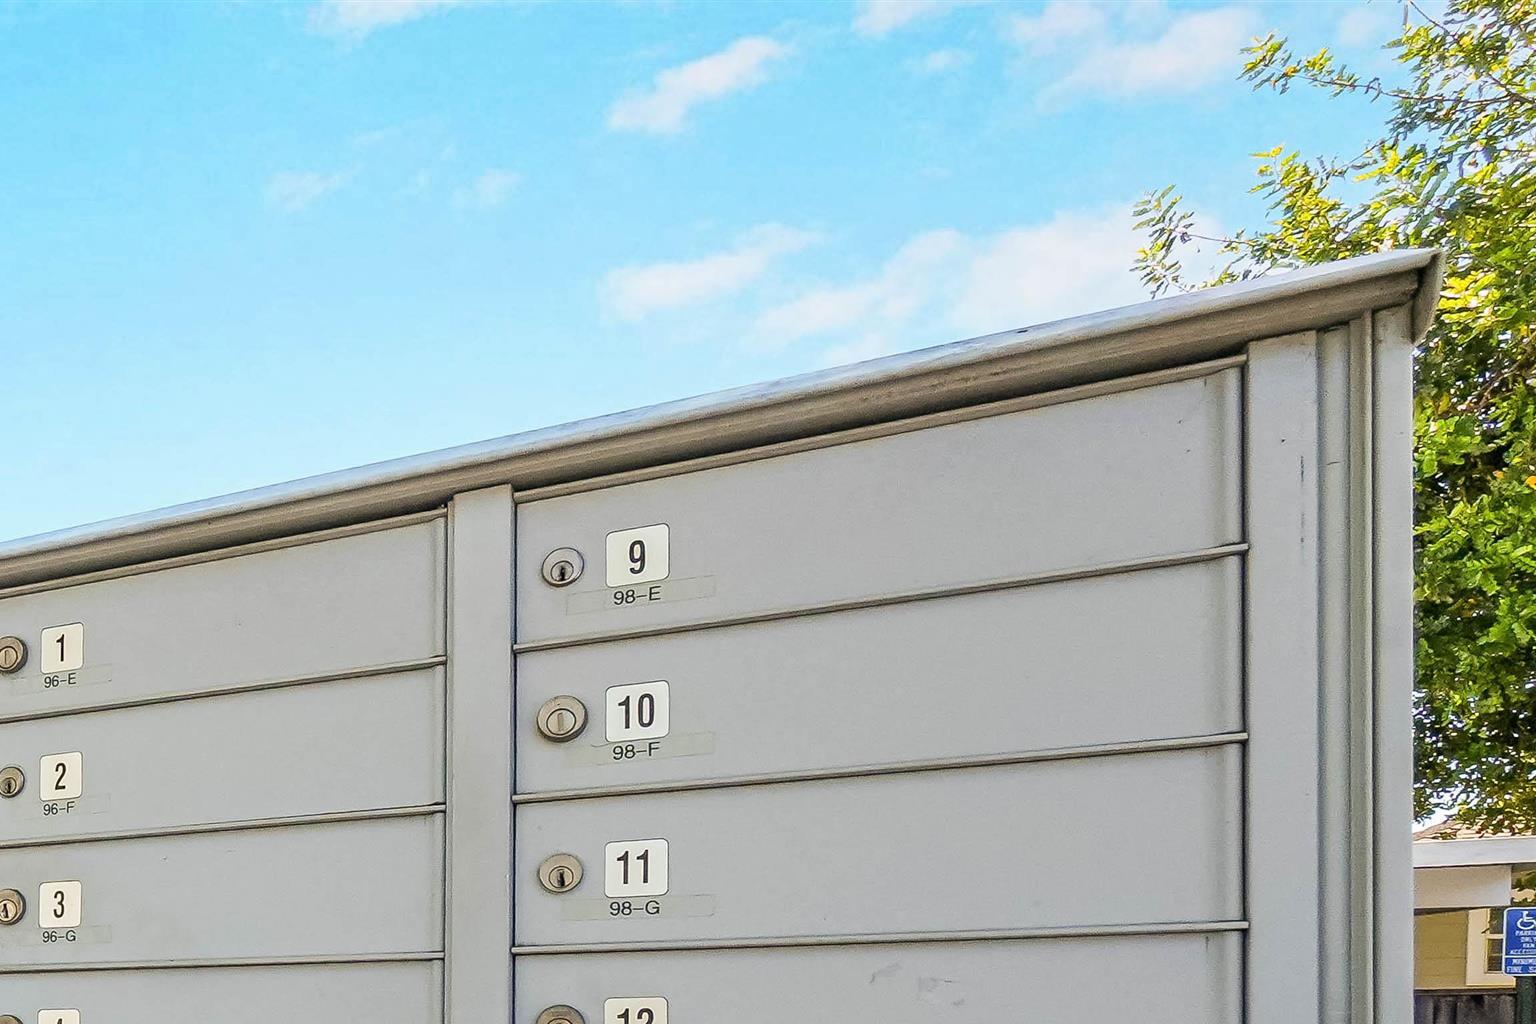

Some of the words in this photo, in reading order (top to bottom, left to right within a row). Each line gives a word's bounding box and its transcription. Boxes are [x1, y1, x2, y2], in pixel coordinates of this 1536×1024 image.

[628, 539, 646, 575] 9
[613, 588, 662, 606] 98-E
[55, 633, 65, 662] 1
[43, 673, 76, 688] 96-E
[618, 693, 655, 729] 10
[613, 742, 660, 760] 98-F
[54, 762, 67, 790] 2
[43, 801, 75, 816] 96-F
[616, 849, 650, 885] 11
[52, 890, 65, 918] 3
[610, 900, 661, 916] 98-G
[42, 930, 76, 943] 96-G
